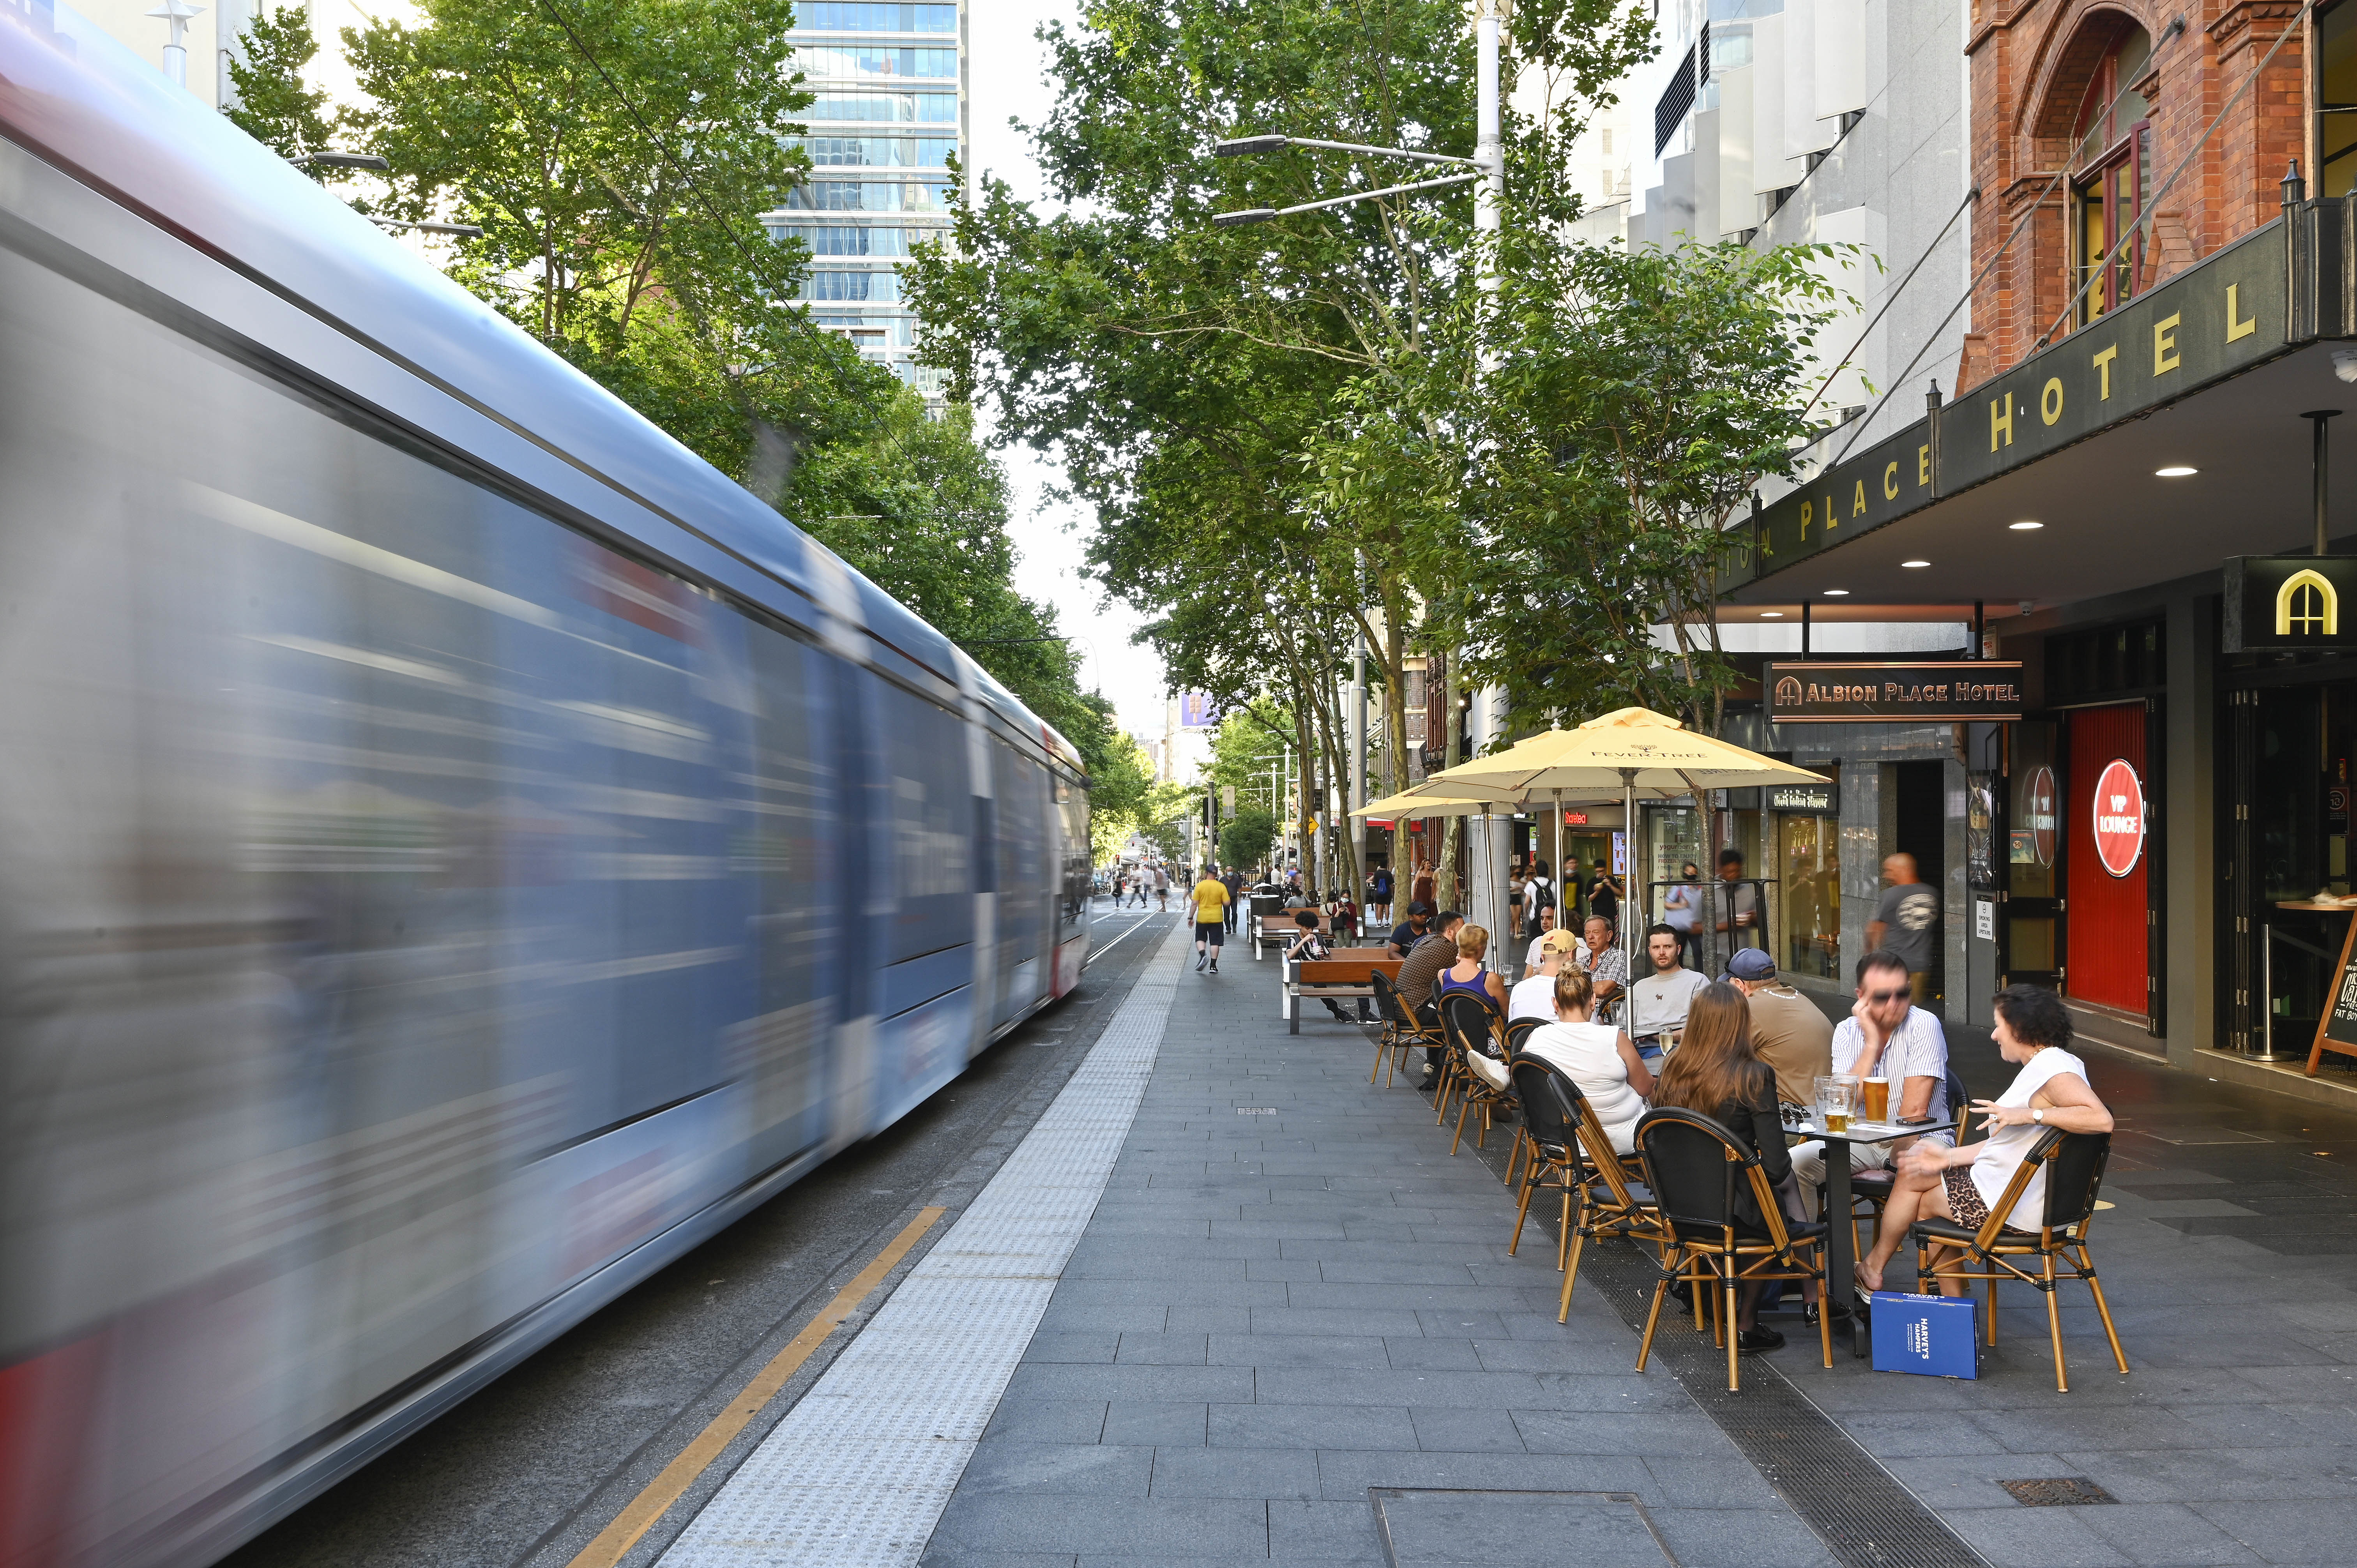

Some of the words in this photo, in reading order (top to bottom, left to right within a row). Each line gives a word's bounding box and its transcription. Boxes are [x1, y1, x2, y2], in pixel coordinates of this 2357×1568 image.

[1801, 444, 1929, 542] PLACE
[1990, 283, 2256, 453] HOTEL
[1806, 683, 1877, 702] ALBION
[1885, 682, 1947, 702] PLACE
[1956, 682, 2020, 701] HOTEL
[1774, 792, 1788, 807] North
[1790, 792, 1806, 807] Indian
[2110, 795, 2126, 812] VIP
[1565, 812, 1587, 824] Sharetea
[2099, 816, 2138, 833] LOUNGE
[2335, 1008, 2346, 1019] FAT
[1921, 1318, 1929, 1359] HARVEY'S
